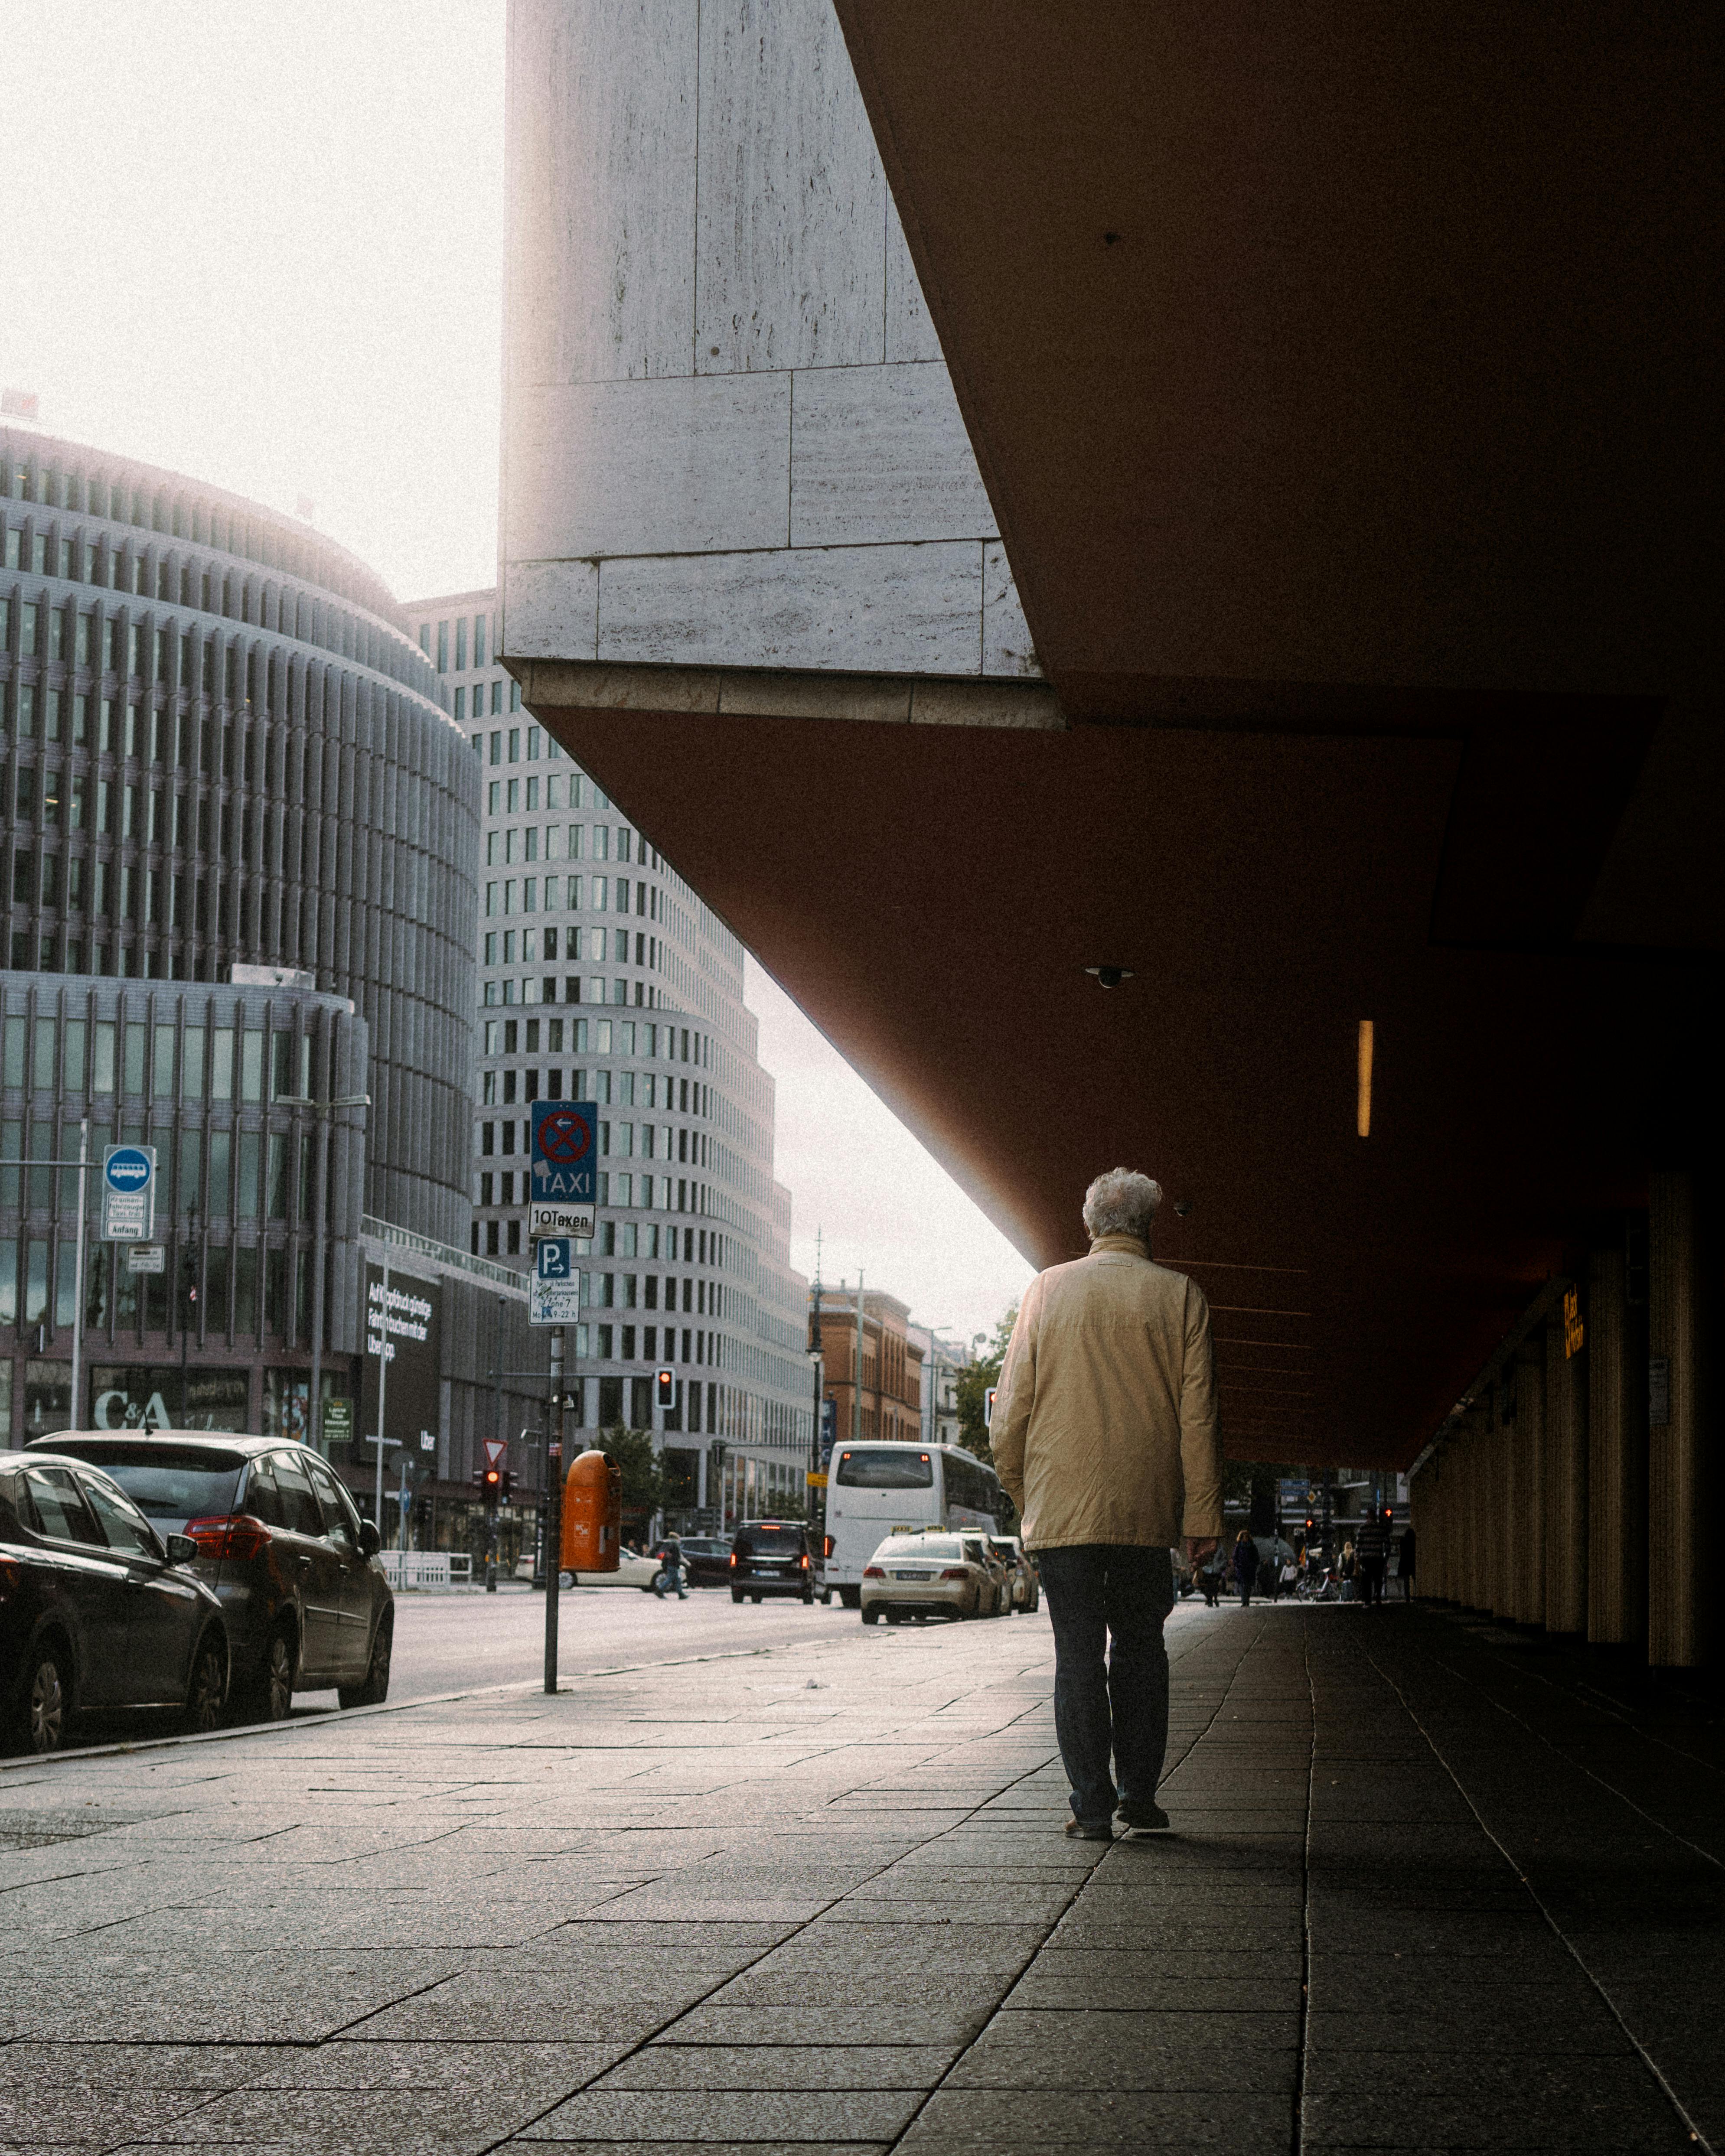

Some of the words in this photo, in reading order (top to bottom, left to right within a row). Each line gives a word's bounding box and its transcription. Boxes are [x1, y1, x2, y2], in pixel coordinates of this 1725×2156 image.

[541, 1172, 590, 1193] TAXI
[112, 1225, 138, 1236] Anfang
[543, 1244, 560, 1274] P
[380, 1284, 409, 1311] Kopfdruck
[565, 1299, 571, 1307] 7
[94, 1390, 172, 1431] C&A
[421, 1430, 435, 1451] Uber
